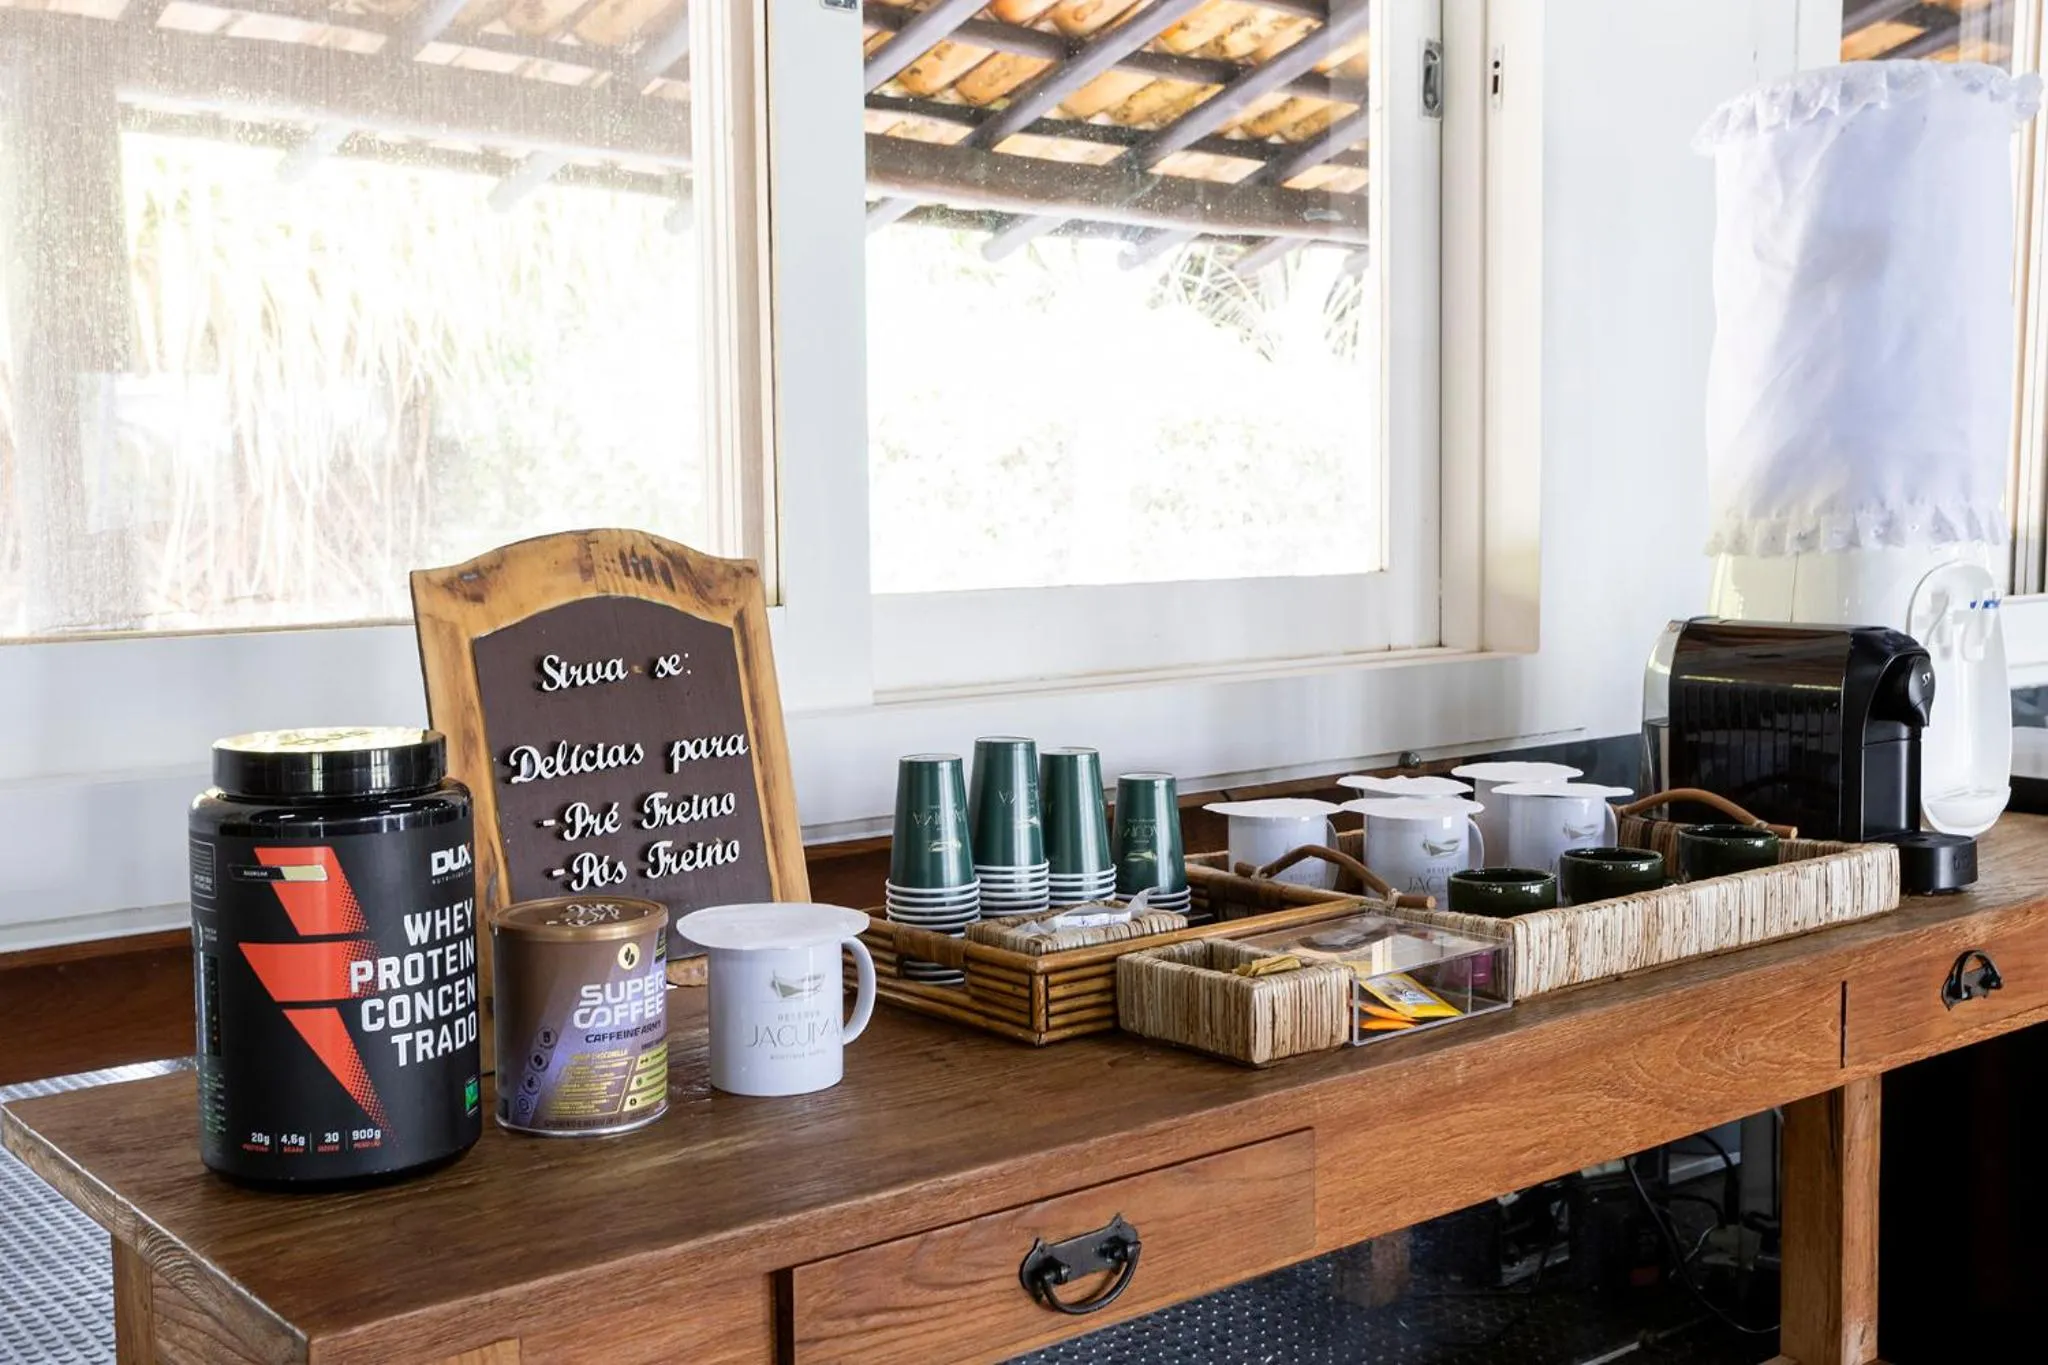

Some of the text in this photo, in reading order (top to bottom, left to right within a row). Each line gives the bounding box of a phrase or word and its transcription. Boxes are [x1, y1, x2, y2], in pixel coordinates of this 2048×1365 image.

[671, 733, 748, 773] para
[642, 791, 736, 830] Treino
[431, 843, 472, 876] DUX
[646, 838, 741, 880] Treino
[404, 897, 473, 946] WHEY
[350, 939, 475, 993] PROTEIN
[361, 979, 475, 1033] CONCEN
[579, 970, 664, 1007] SUPER
[573, 991, 664, 1029] COFFEE
[391, 1015, 477, 1067] TRADO
[251, 1132, 270, 1146] 20g
[280, 1133, 305, 1146] 4,6g
[324, 1132, 339, 1144] 30
[352, 1128, 381, 1141] 900g
